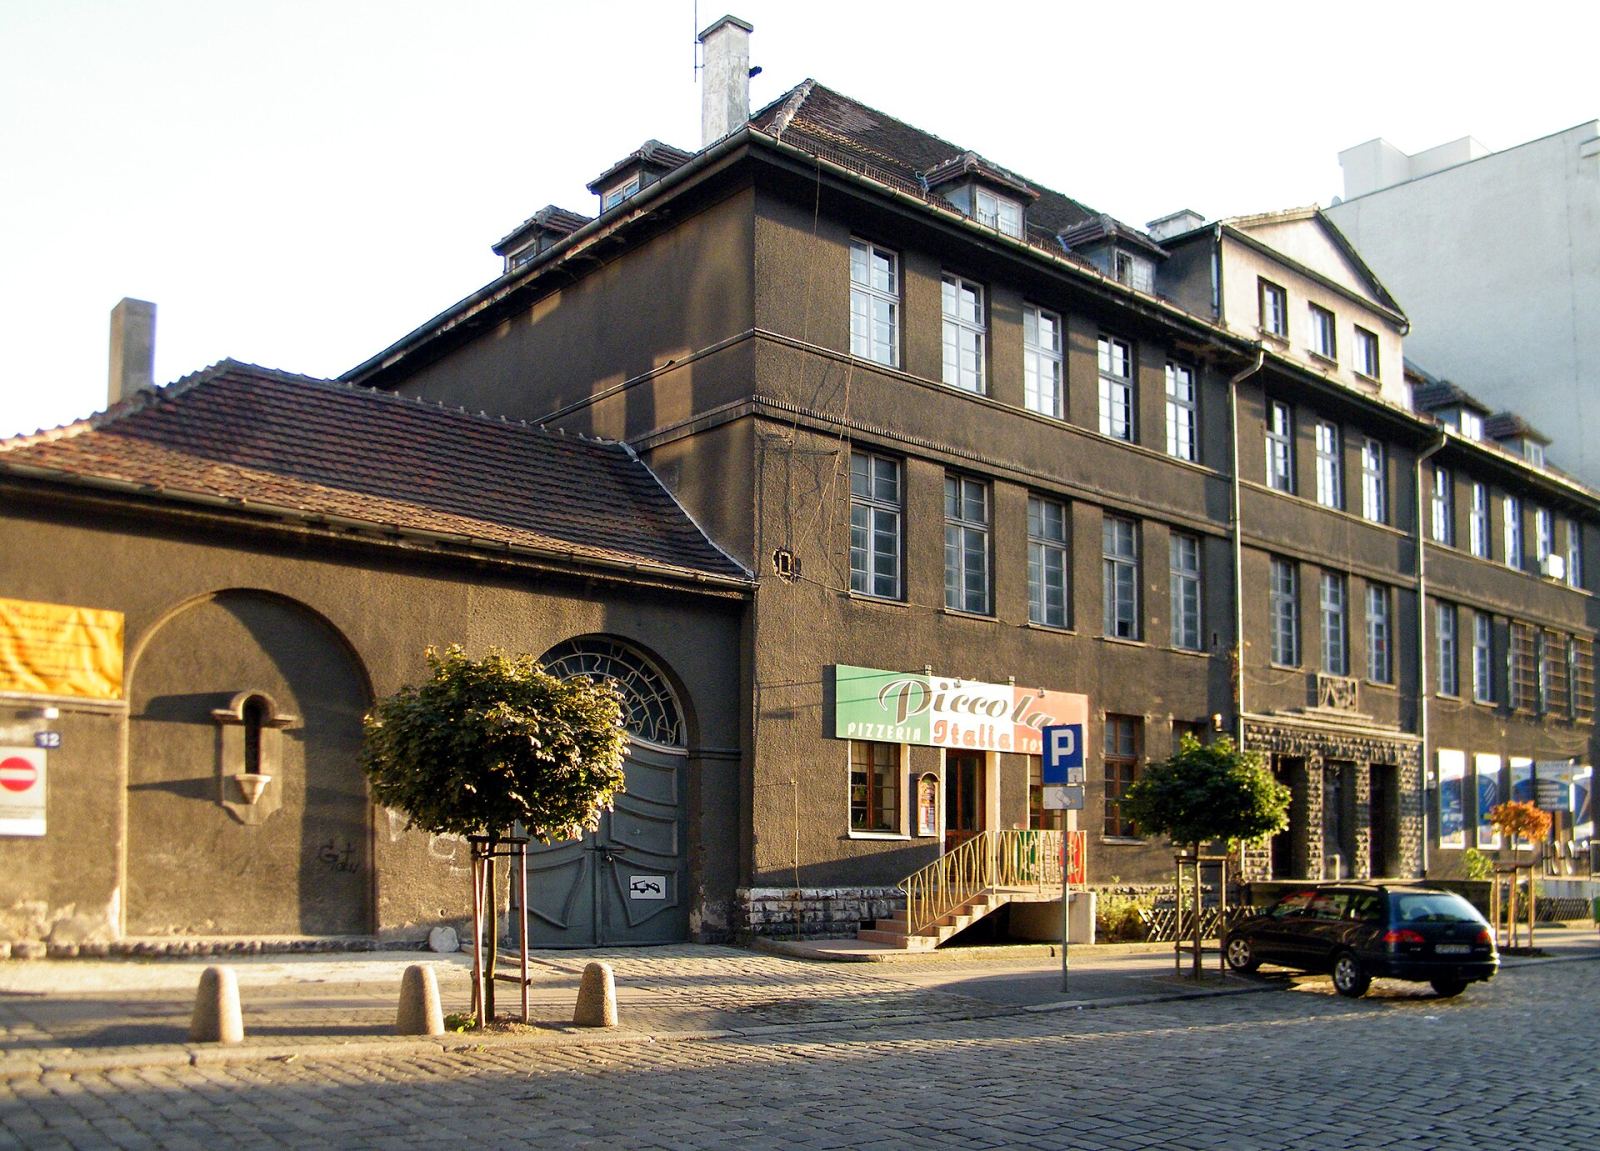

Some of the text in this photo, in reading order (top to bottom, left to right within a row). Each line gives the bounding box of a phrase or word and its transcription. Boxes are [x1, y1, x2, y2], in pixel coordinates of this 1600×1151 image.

[878, 679, 1055, 732] Piccola
[39, 732, 60, 747] 12
[847, 722, 921, 741] PIZZERIA
[1051, 729, 1074, 766] P
